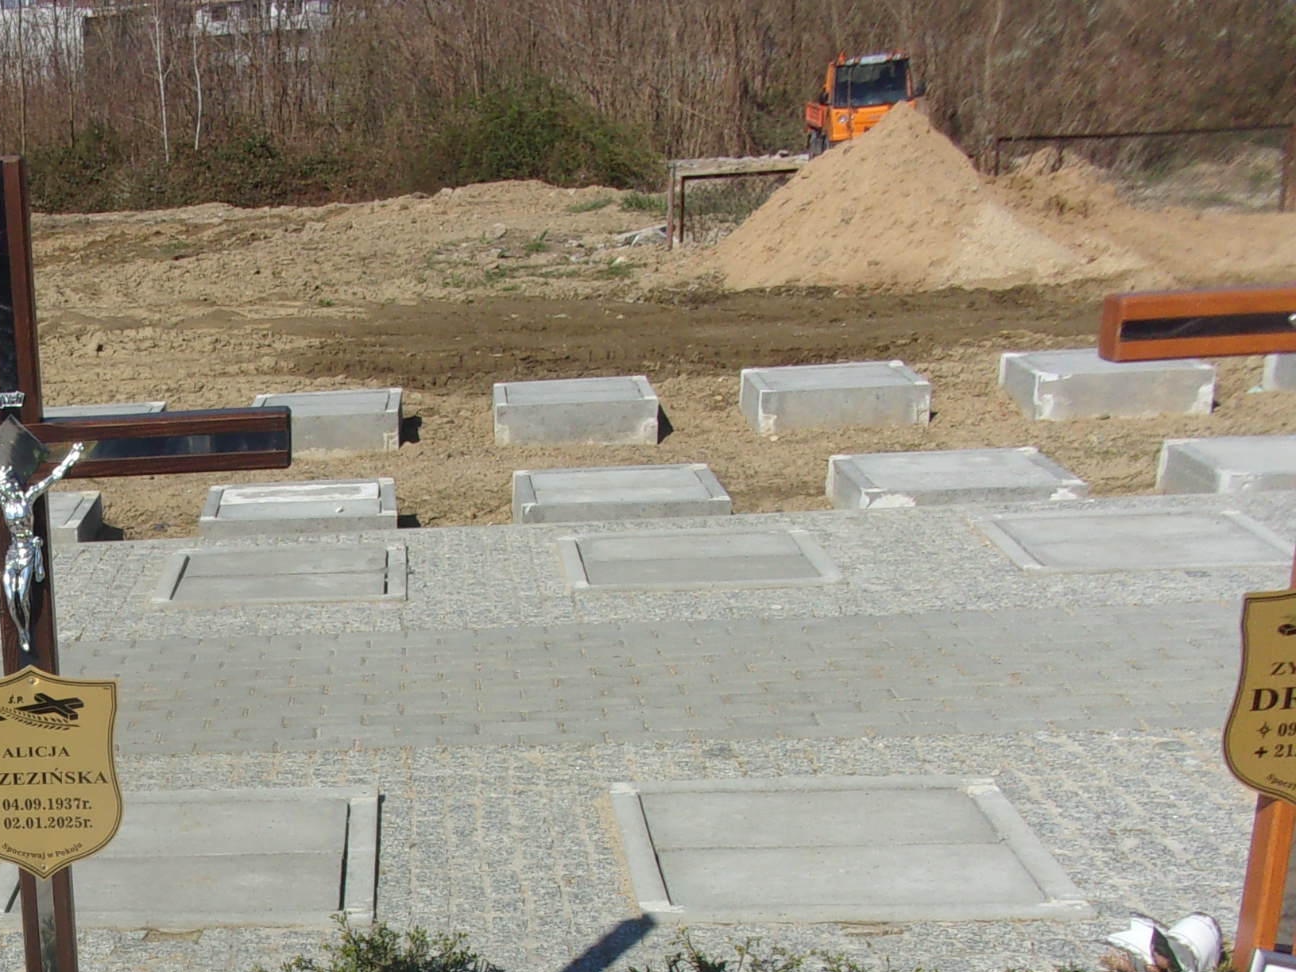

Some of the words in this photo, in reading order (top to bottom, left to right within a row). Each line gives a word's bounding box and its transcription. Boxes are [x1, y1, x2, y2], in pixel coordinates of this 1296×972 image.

[2, 746, 70, 758] ALICJA
[2, 797, 93, 811] 04.09.1937r.
[3, 815, 94, 830] 02.01.2025r.
